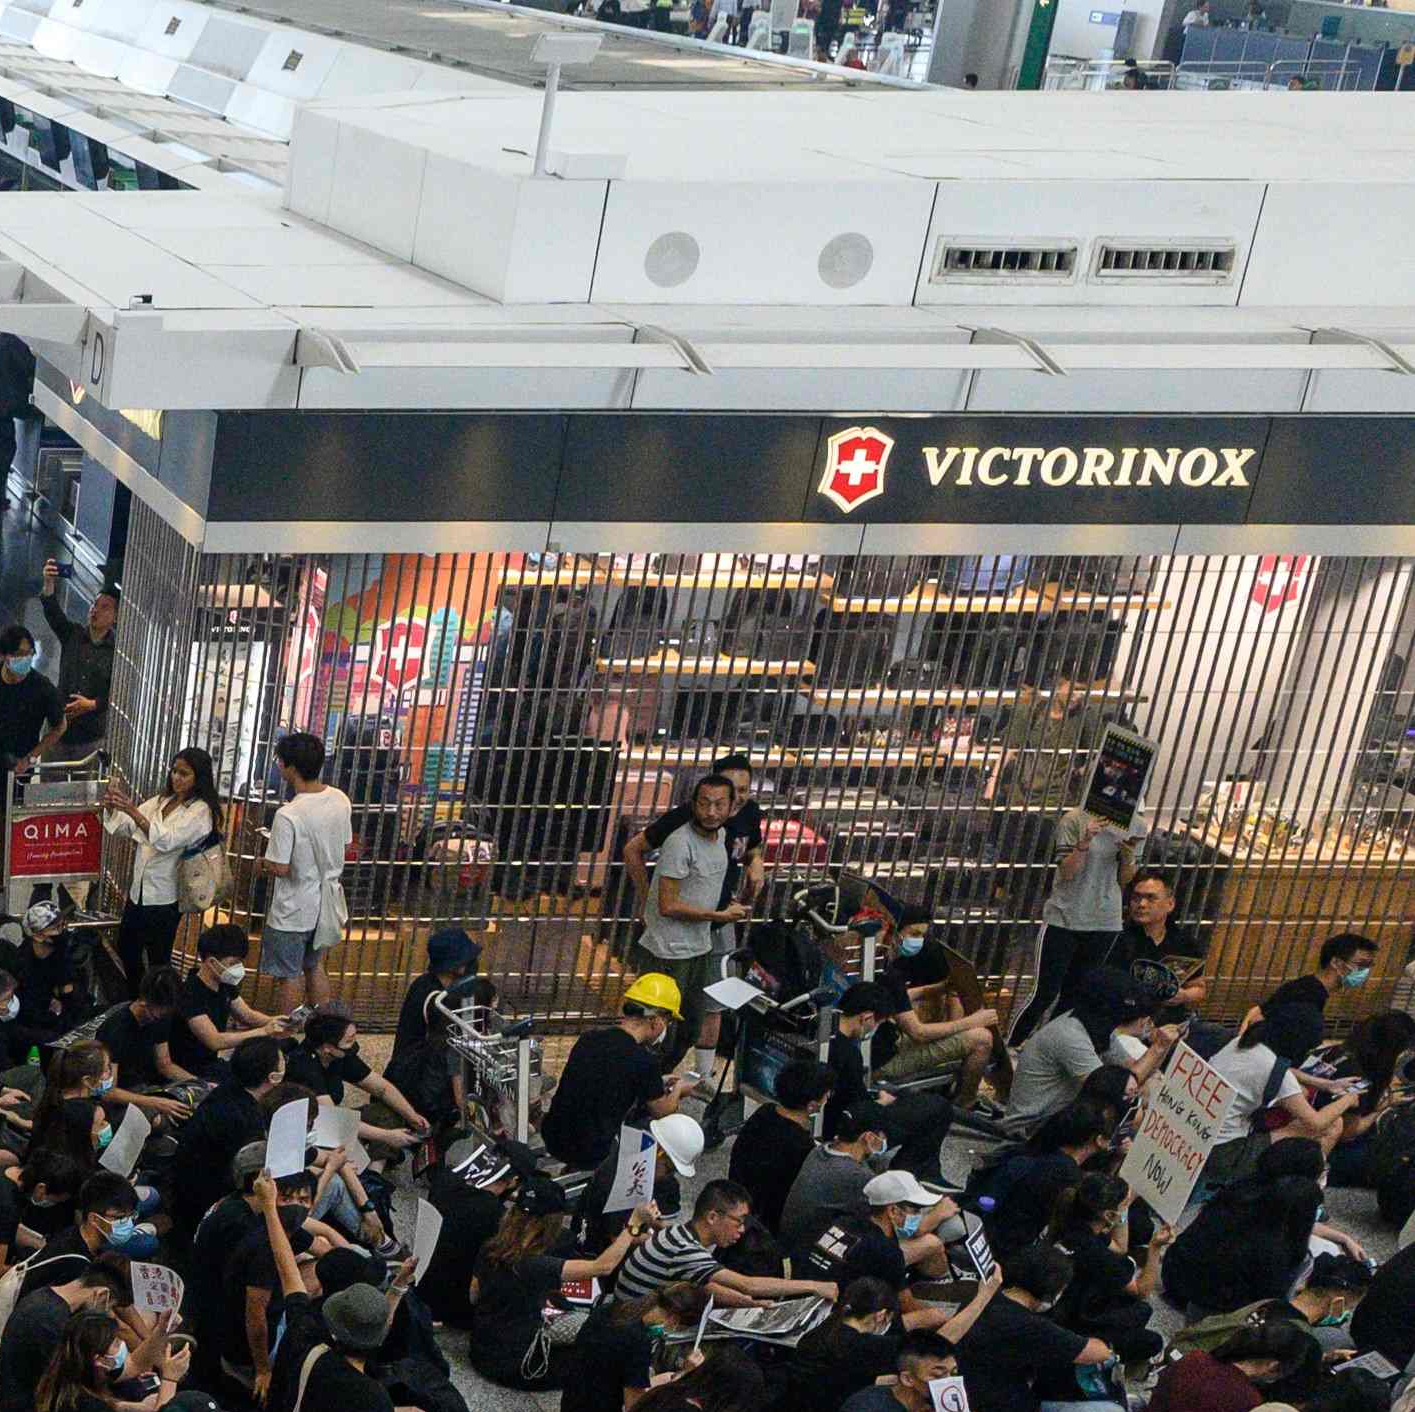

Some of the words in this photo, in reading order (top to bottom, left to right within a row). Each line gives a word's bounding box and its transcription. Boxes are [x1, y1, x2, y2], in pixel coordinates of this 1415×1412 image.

[91, 332, 104, 385] D
[923, 447, 1257, 488] VICTORINOX
[24, 823, 88, 840] QIMA
[1170, 1051, 1229, 1119] FREE
[1143, 1110, 1205, 1179] DEMOCRACY
[1144, 1153, 1171, 1196] NOW
